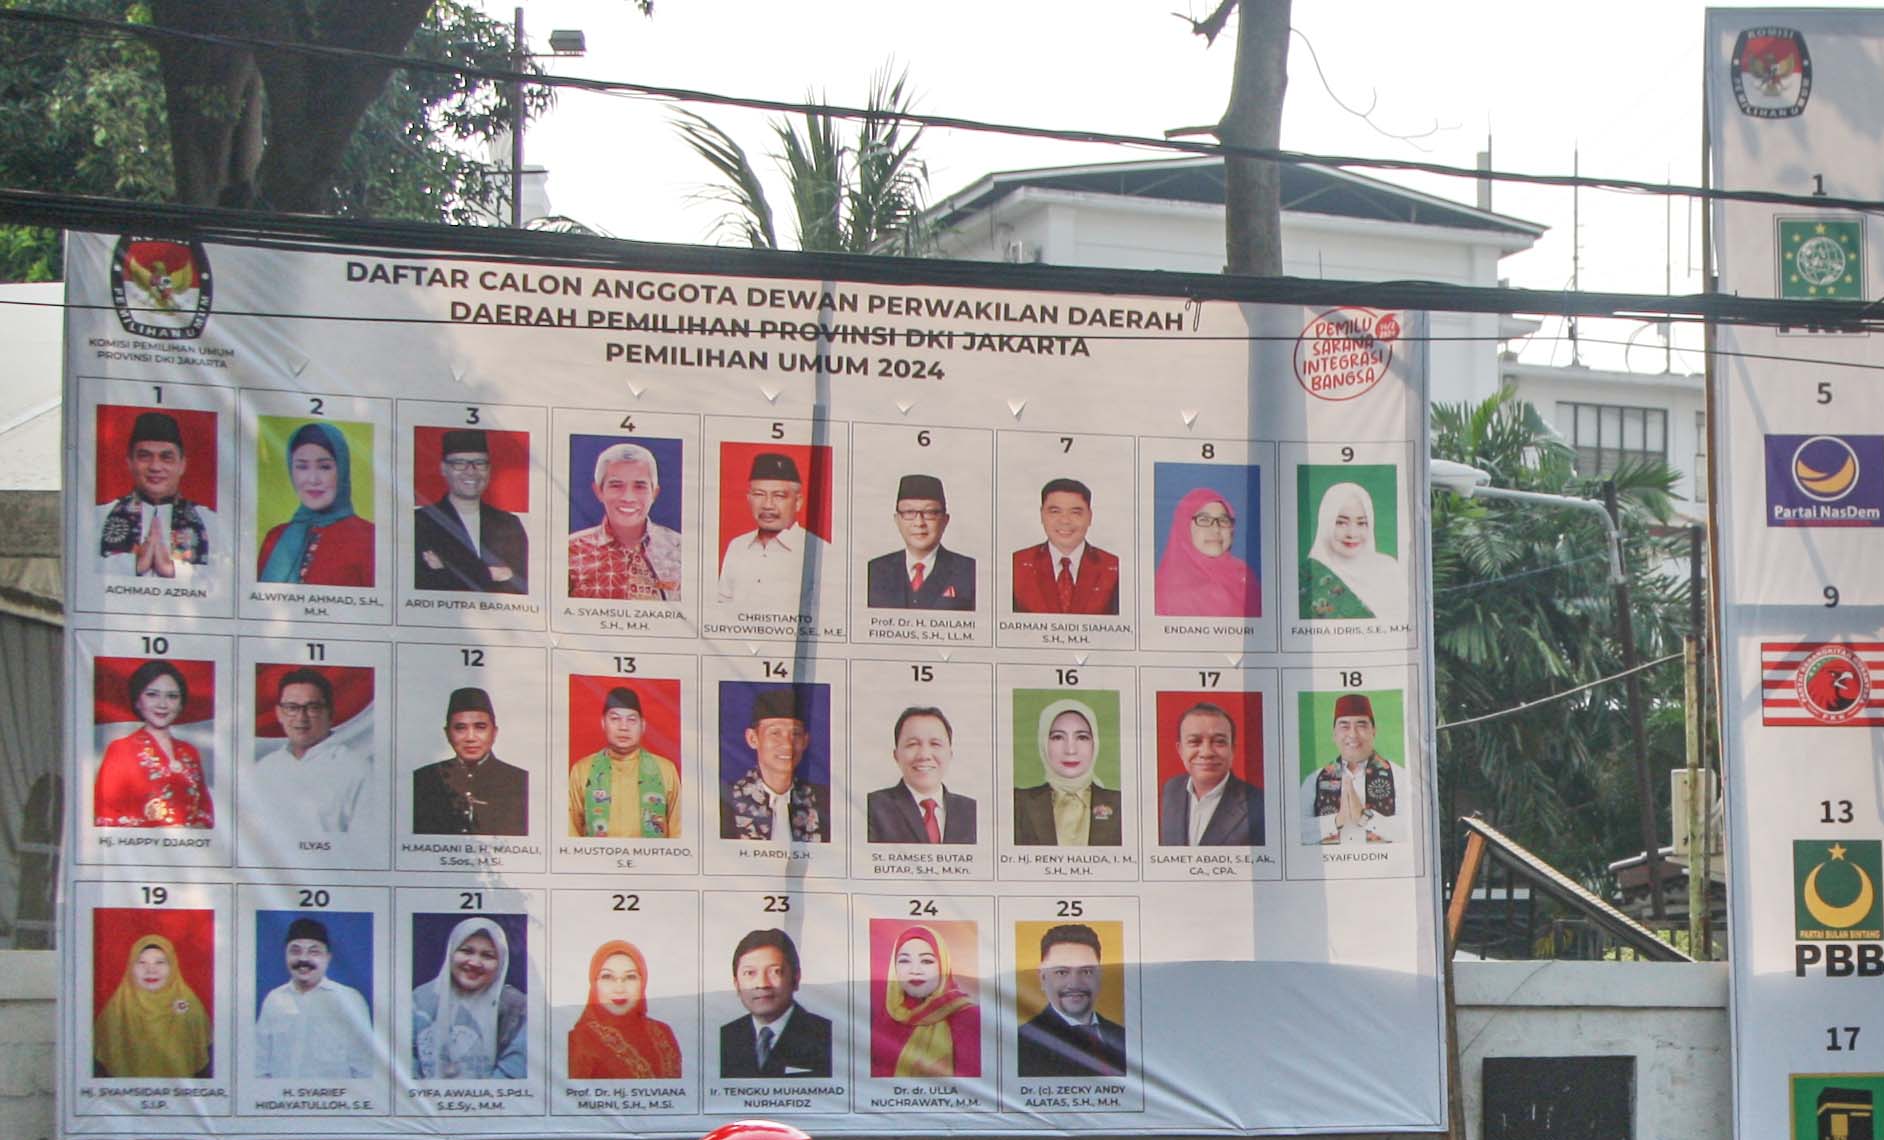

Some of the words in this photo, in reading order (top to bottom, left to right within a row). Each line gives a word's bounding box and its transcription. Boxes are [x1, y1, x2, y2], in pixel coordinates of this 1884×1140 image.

[1812, 174, 1828, 197] 1
[345, 260, 470, 289] DAFTAR
[478, 270, 583, 296] CALON
[591, 279, 739, 307] ANGGOTA
[746, 287, 859, 313] DEWAN
[867, 294, 1059, 324] PERWAKILAN
[1067, 306, 1185, 331] DAERAH
[450, 301, 577, 328] DAERAH
[587, 310, 751, 339] PEMILIHAN
[760, 319, 896, 347] PROVINSI
[905, 328, 954, 349] DKI
[963, 332, 1091, 358] JAKARTA
[1315, 317, 1373, 338] PEMILU
[1312, 334, 1375, 356] SARANA
[605, 342, 769, 371] PEMILIHAN
[778, 352, 870, 376] UMUM
[877, 358, 946, 381] 2024
[1303, 349, 1384, 375] INTEGRASI
[1311, 367, 1376, 391] BANGSA
[152, 385, 162, 404] 1
[1816, 381, 1833, 405] 5
[310, 398, 324, 415] 2
[466, 406, 481, 425] 3
[619, 414, 637, 433] 4
[770, 422, 785, 441] 5
[916, 429, 932, 448] 6
[1058, 436, 1075, 455] 7
[1200, 442, 1216, 461] 8
[1340, 445, 1356, 464] 9
[1774, 504, 1817, 521] Partai
[1819, 504, 1881, 521] NasDem
[104, 584, 162, 597] ACHMAD
[163, 587, 208, 600] AZRAN
[248, 591, 306, 604] ALWIYAH
[1822, 584, 1840, 609] 9
[404, 598, 435, 610] ARDI
[437, 599, 477, 611] PUTRA
[479, 601, 541, 615] BARAMULI
[577, 607, 633, 619] SYAMSUL
[737, 612, 814, 625] CHRISTIANTO
[929, 619, 977, 631] DAILAMI
[999, 620, 1049, 632] DARMAN
[1050, 621, 1081, 633] SAIDI
[1163, 624, 1211, 636] ENDANG
[1212, 625, 1256, 637] WIDURI
[1290, 625, 1332, 637] FAHIRA
[140, 636, 170, 655] 10
[305, 642, 326, 662] 11
[460, 648, 485, 668] 12
[613, 656, 638, 674] 13
[761, 661, 789, 679] 14
[910, 665, 935, 683] 15
[1055, 668, 1080, 686] 16
[1198, 671, 1222, 689] 17
[1339, 671, 1363, 688] 18
[1819, 799, 1855, 824] 13
[117, 836, 160, 849] HAPPY
[161, 837, 212, 849] DJAROT
[573, 846, 631, 857] MUSTOPA
[888, 853, 934, 864] RAMSES
[936, 853, 974, 864] BUTAR
[1035, 854, 1064, 865] RENY
[1149, 854, 1193, 865] SLAMET
[1322, 851, 1390, 863] SYAIFUDDIN
[140, 885, 169, 905] 19
[298, 889, 331, 909] 20
[459, 891, 484, 910] 21
[611, 893, 641, 913] 22
[762, 895, 791, 914] 23
[908, 899, 939, 917] 24
[1055, 899, 1084, 918] 25
[1824, 1026, 1862, 1052] 17
[298, 1087, 347, 1098] SYARIEF
[630, 1087, 687, 1098] SYLVIANA
[723, 1086, 771, 1098] TENGKU
[772, 1086, 846, 1097] MUHAMMAD
[928, 1086, 959, 1096] ULLA
[1056, 1085, 1093, 1096] ZECKY
[1094, 1084, 1127, 1096] ANDY
[743, 1098, 812, 1109] NURHAFIDZ
